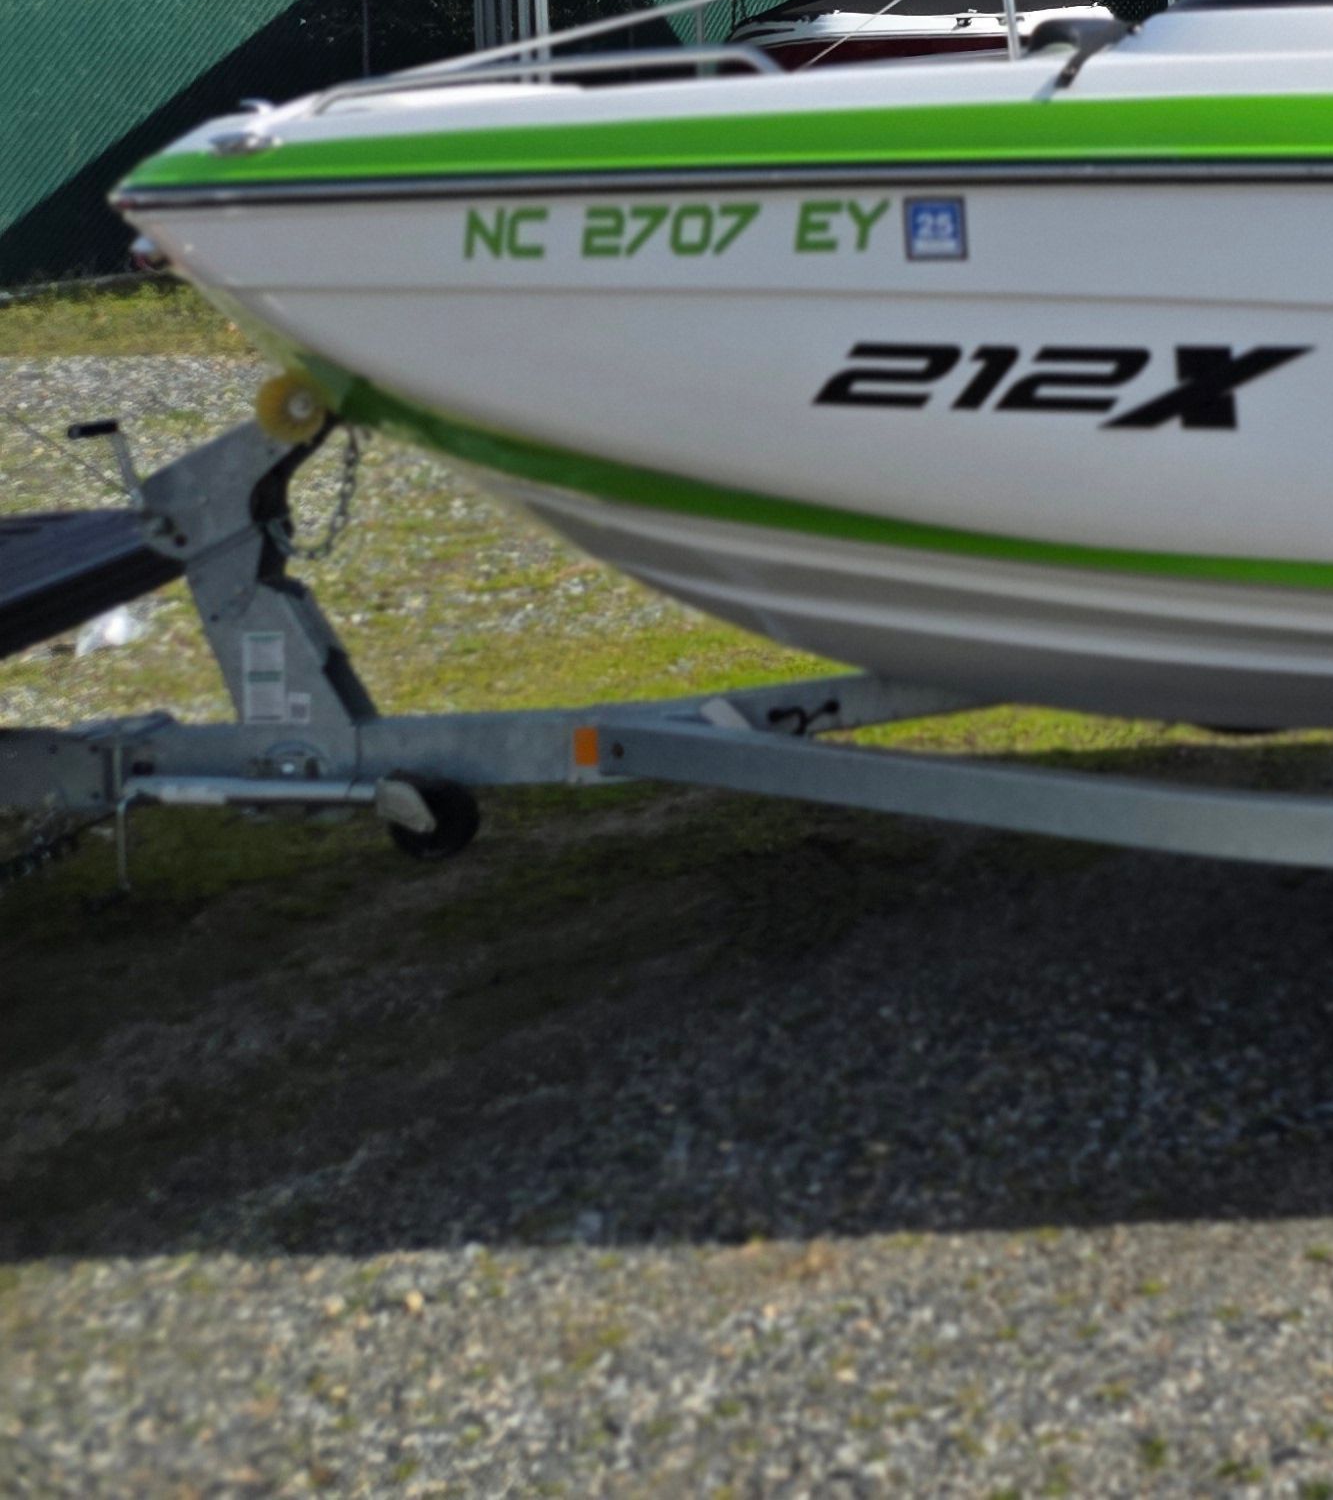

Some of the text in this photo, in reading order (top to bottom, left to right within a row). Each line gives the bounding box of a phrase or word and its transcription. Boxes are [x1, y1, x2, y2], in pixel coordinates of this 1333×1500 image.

[464, 199, 891, 260] NC 2707 EY
[916, 211, 954, 238] 25
[811, 341, 1316, 431] 212X
